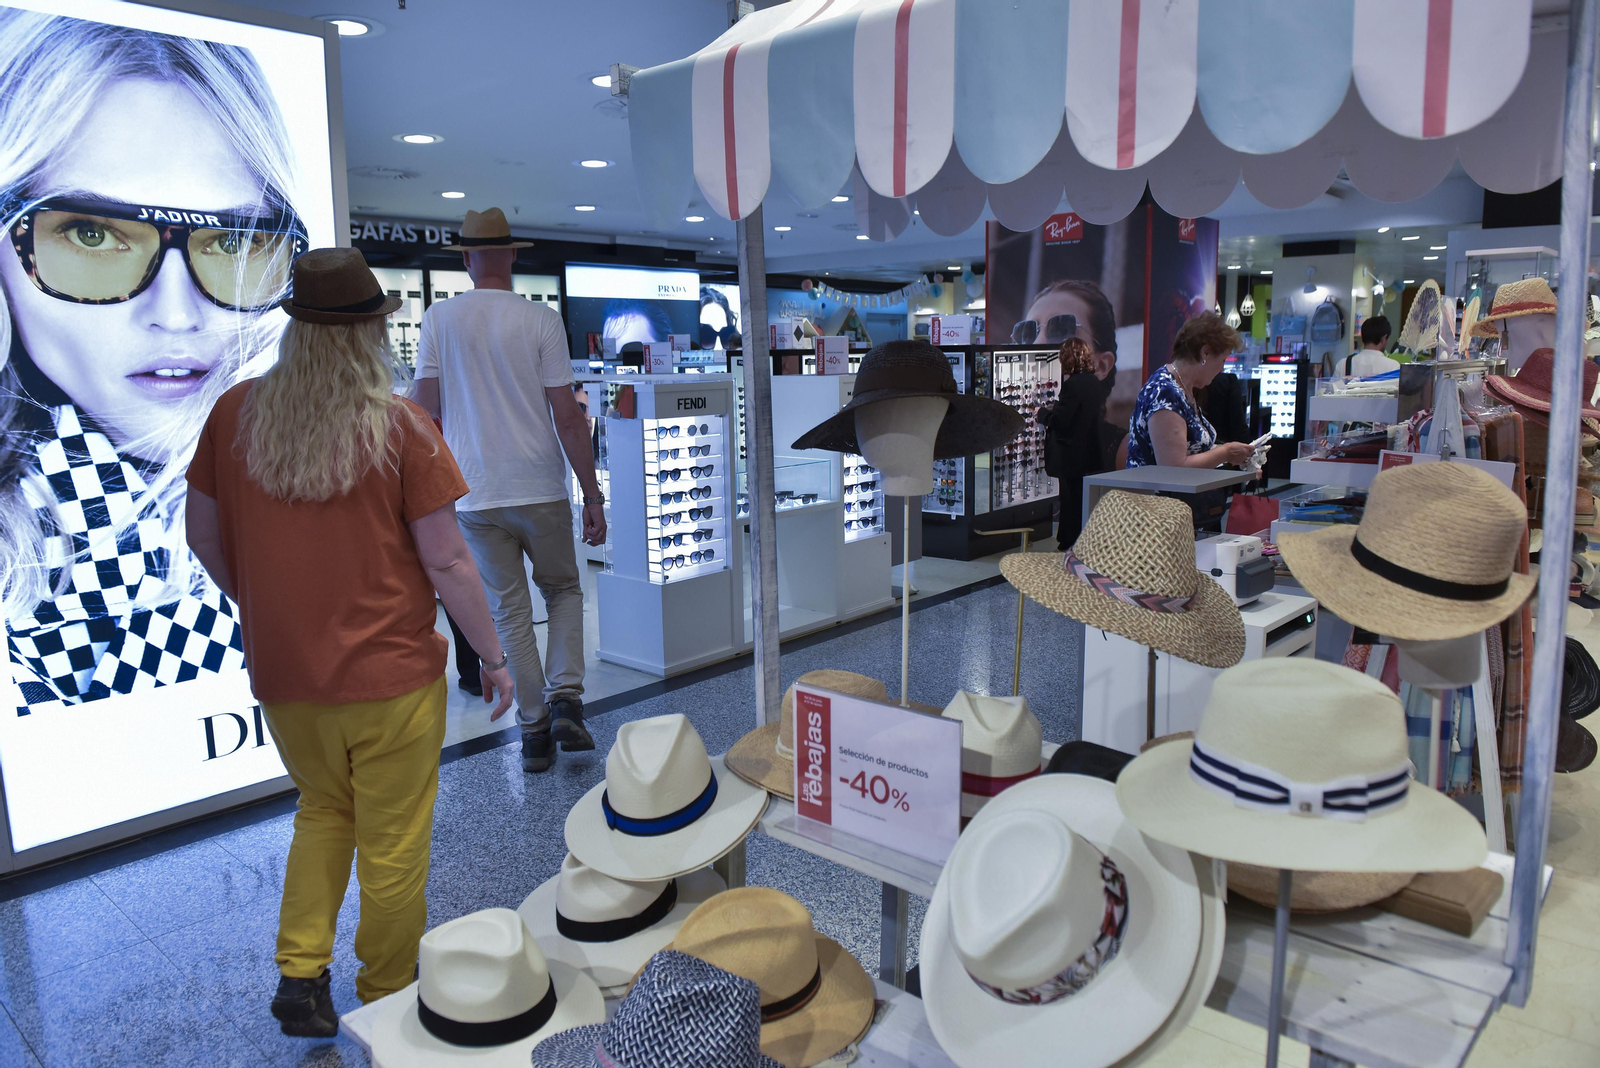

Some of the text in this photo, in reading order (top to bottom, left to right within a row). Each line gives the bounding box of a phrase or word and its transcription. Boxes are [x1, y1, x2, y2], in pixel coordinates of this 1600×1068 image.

[138, 208, 222, 228] J'ADIOR
[350, 219, 418, 243] GAFAS
[425, 225, 452, 245] DE
[658, 285, 686, 293] PRADA
[942, 330, 960, 338] -40%
[826, 356, 841, 365] -40%
[677, 397, 706, 410] FENDI
[198, 705, 270, 762] DI
[804, 711, 826, 806] rebajas
[839, 746, 929, 779] Selección de productos
[839, 770, 910, 812] -40%
